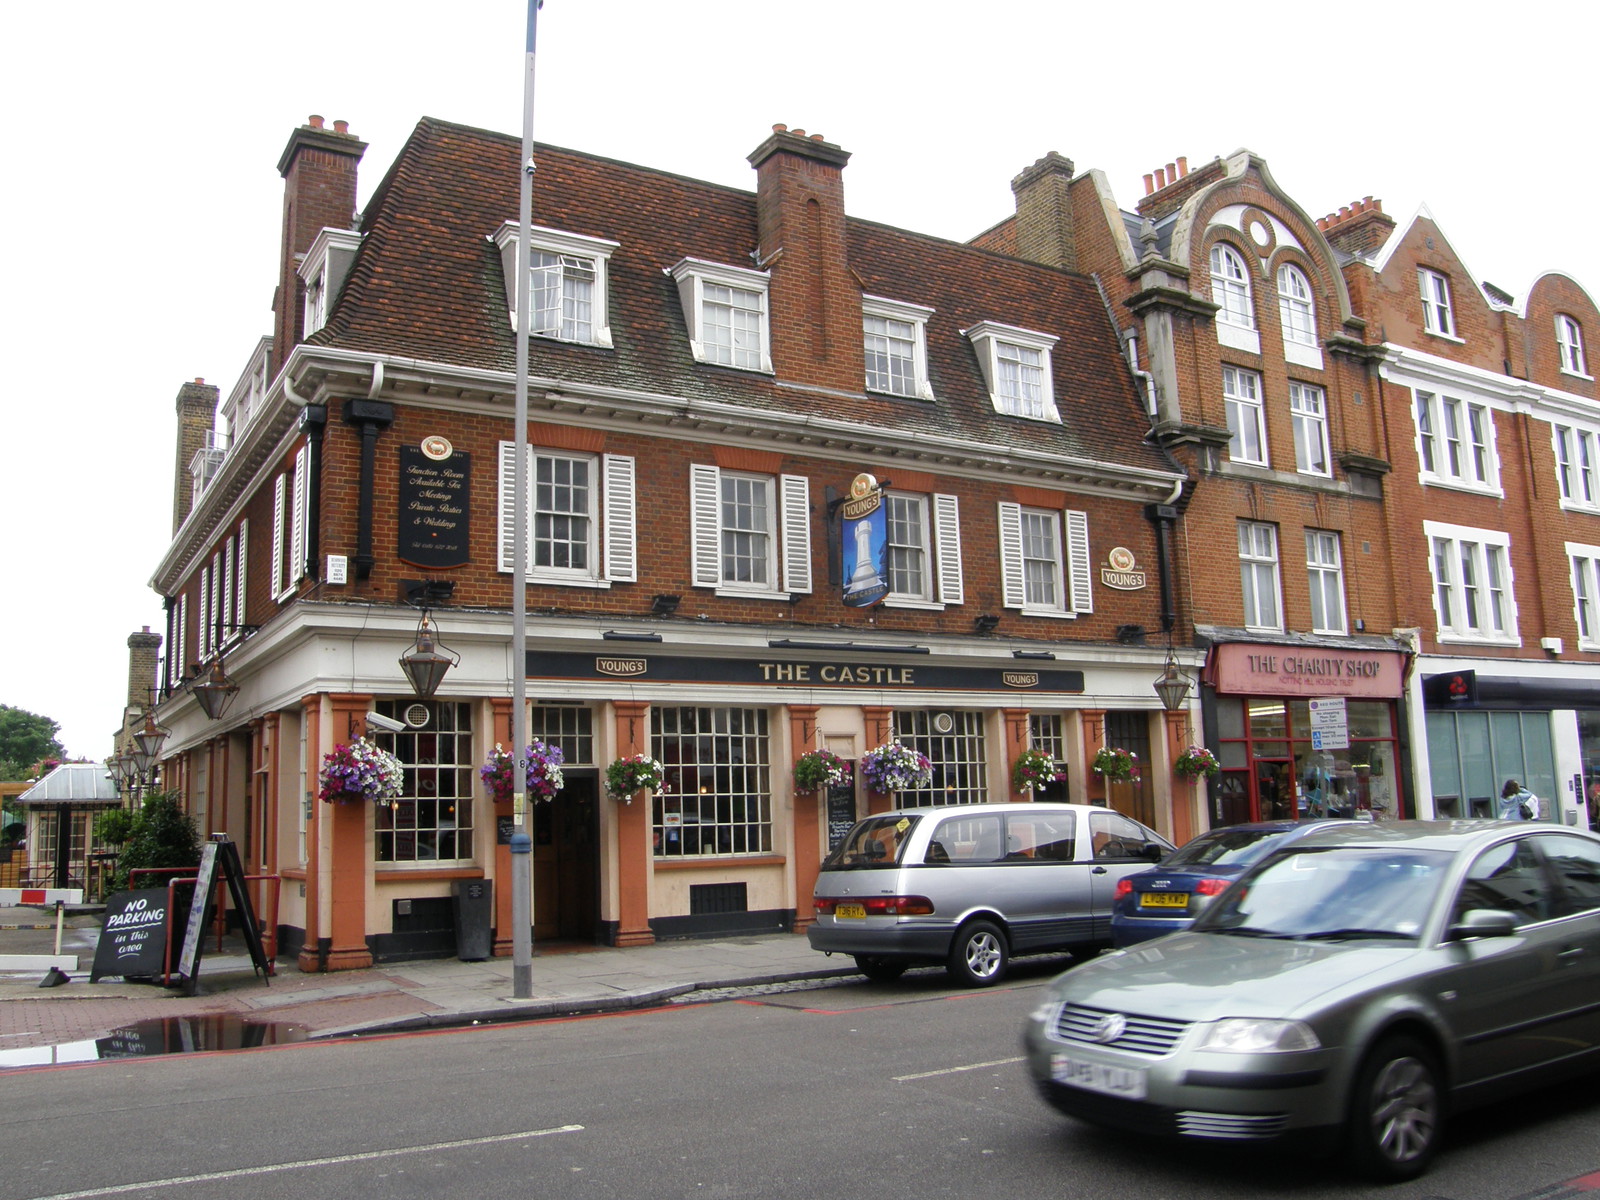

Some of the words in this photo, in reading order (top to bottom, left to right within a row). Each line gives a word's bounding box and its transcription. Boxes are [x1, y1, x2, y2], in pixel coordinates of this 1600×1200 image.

[406, 465, 438, 476] Function
[440, 468, 465, 479] Room
[409, 476, 446, 488] Available
[447, 480, 462, 489] For
[418, 490, 452, 502] Meetings
[408, 500, 436, 511] Private
[437, 503, 463, 514] Parties
[846, 495, 878, 516] YOUNG'S
[413, 516, 421, 525] &
[423, 516, 457, 530] Weddings
[1105, 572, 1143, 586] YOUNG'S
[600, 660, 643, 672] YOUNG'S
[1248, 655, 1278, 674] THE
[1283, 656, 1344, 676] CHARITY
[1346, 660, 1380, 678] SHOP
[759, 663, 811, 681] THE
[820, 665, 915, 684] CASTLE
[1006, 674, 1036, 684] YOUNG'S
[124, 898, 148, 913] NO
[107, 908, 165, 928] PARKING
[115, 934, 127, 943] in
[131, 930, 149, 941] this
[118, 943, 143, 954] area
